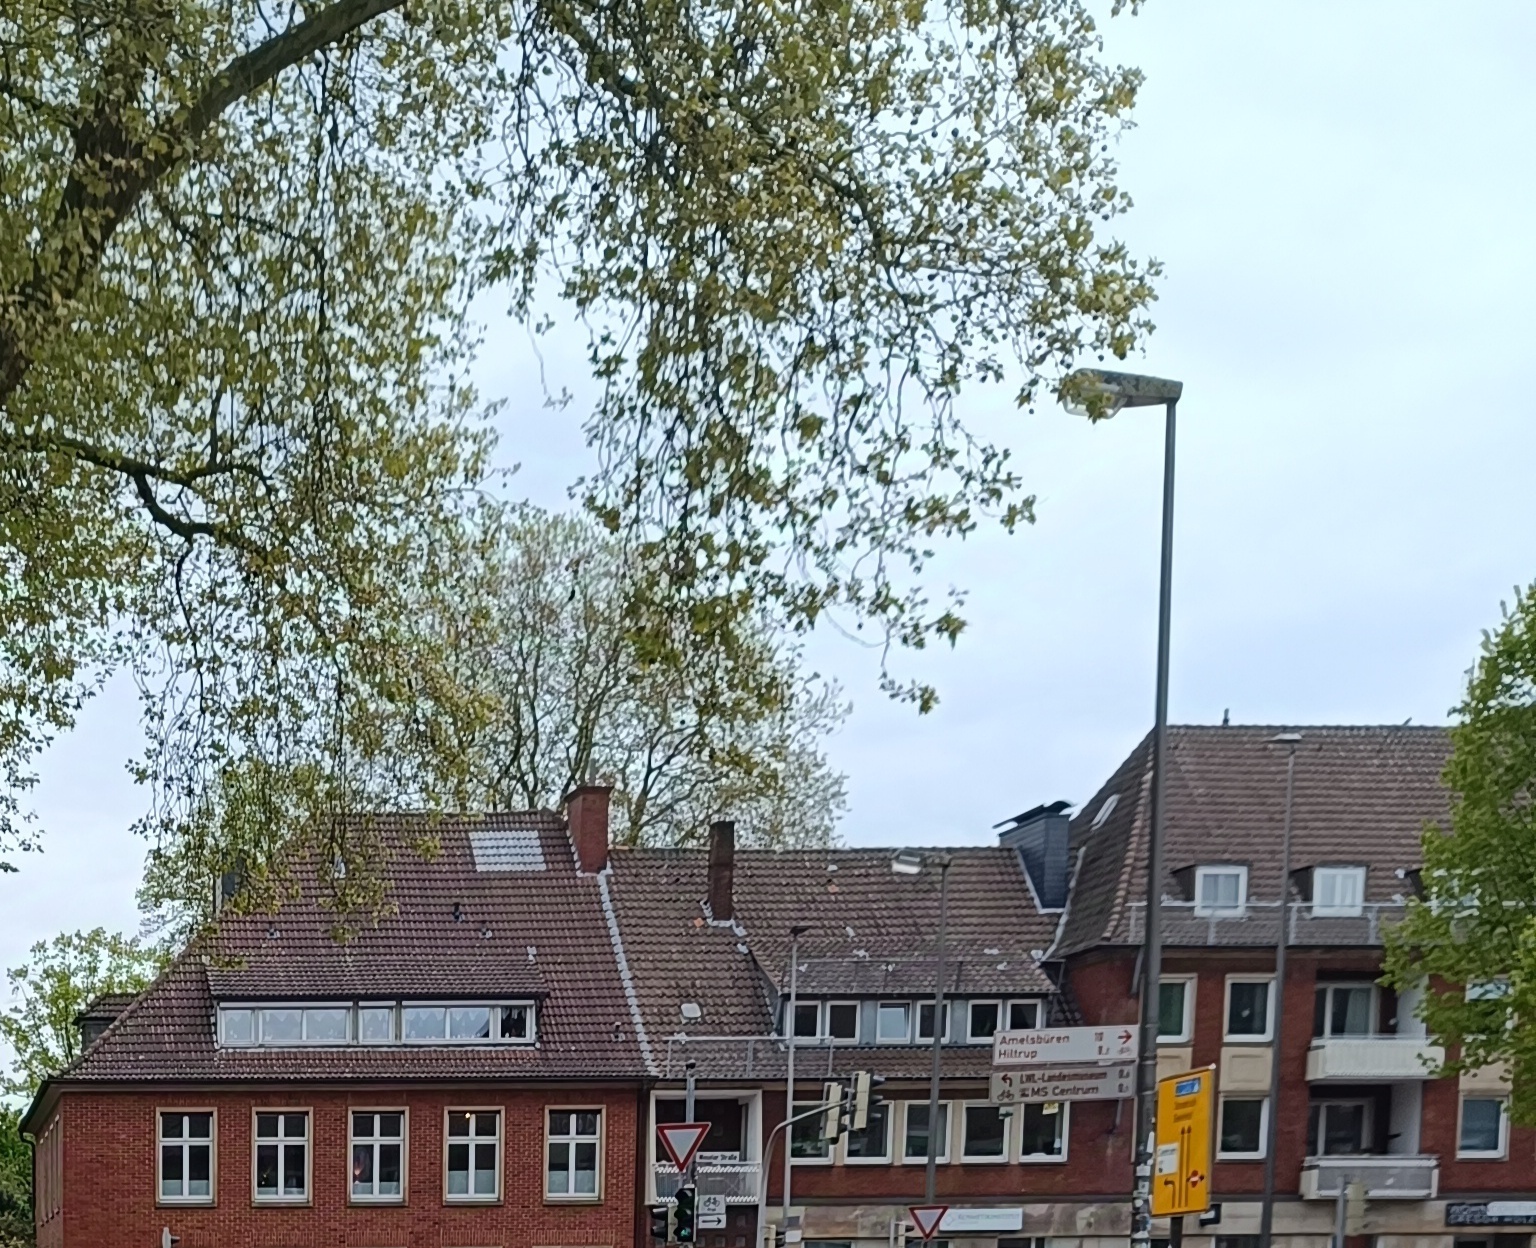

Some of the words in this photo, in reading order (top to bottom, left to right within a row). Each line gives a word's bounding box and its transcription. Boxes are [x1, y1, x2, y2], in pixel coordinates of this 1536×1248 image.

[999, 1033, 1070, 1046] Amelsbüren
[998, 1049, 1038, 1060] Hiltrup
[1052, 1085, 1099, 1096] Centrum
